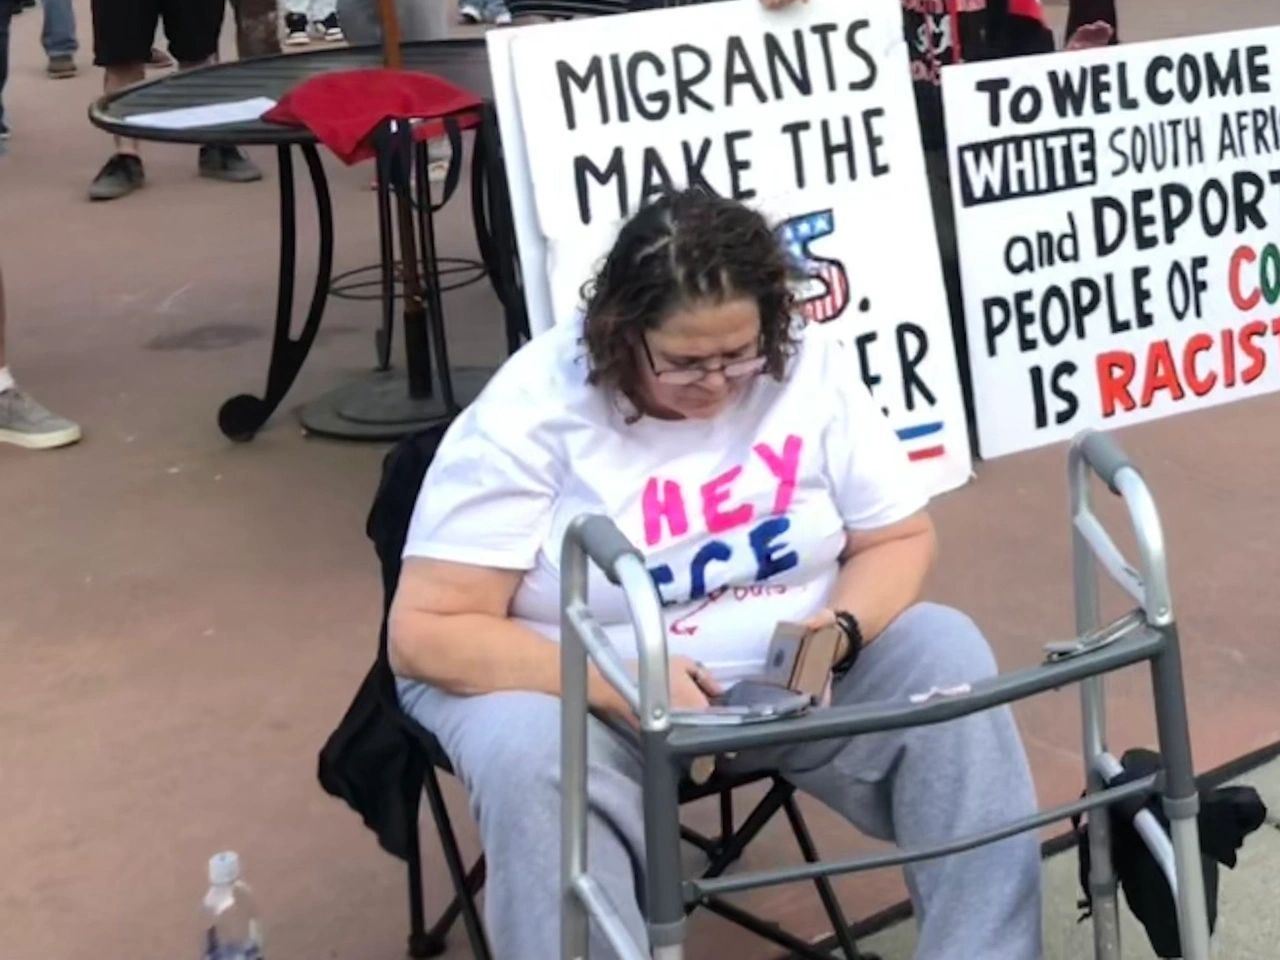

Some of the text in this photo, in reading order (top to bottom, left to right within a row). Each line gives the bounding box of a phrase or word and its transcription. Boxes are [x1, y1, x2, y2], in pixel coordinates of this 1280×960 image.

[555, 20, 879, 131] MIGRANTS
[1047, 45, 1271, 119] WELCOME
[574, 130, 757, 225] MAKE
[782, 107, 890, 189] THE
[960, 132, 1095, 203] WHITE
[1108, 117, 1205, 177] SOUTH
[1004, 211, 1079, 274] and
[982, 266, 1153, 358] PEOPLE
[1167, 256, 1209, 321] OF
[1029, 361, 1079, 429] IS
[642, 434, 803, 545] HEY
